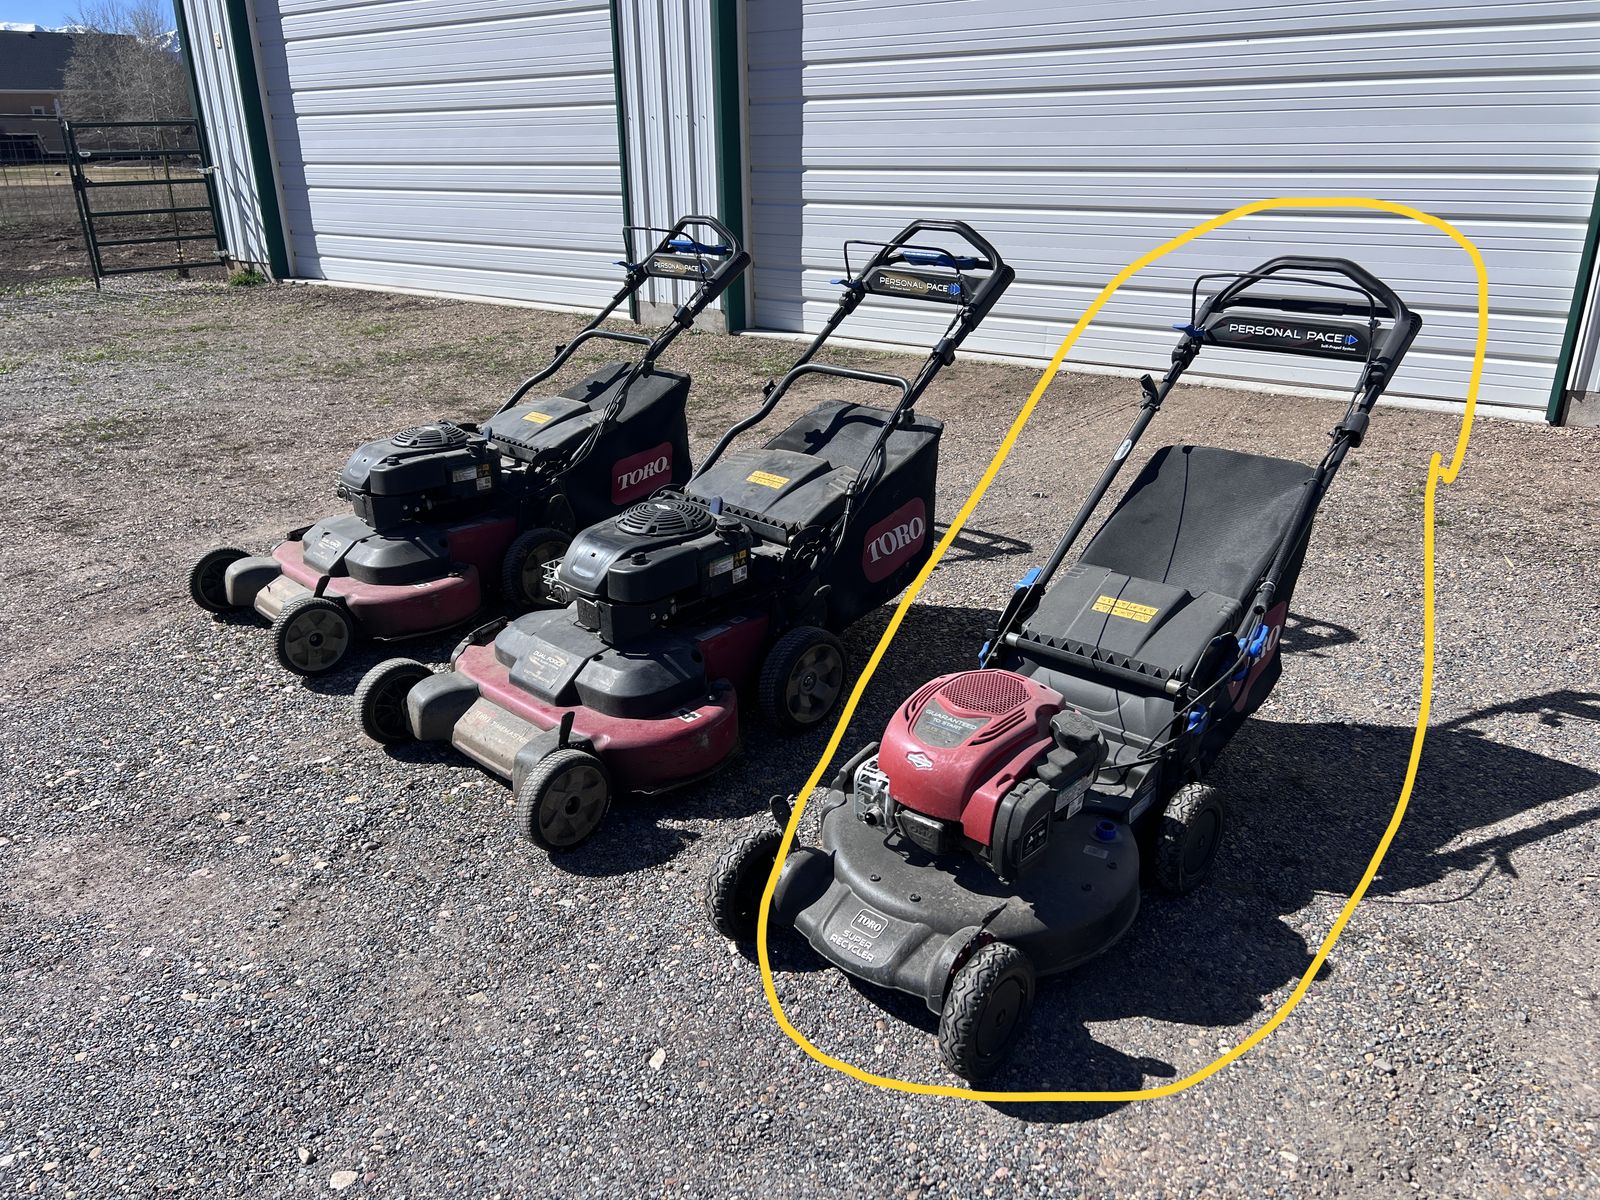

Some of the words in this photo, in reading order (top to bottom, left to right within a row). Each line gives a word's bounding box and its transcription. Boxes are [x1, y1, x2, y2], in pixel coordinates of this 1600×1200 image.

[653, 261, 683, 271] PERSONAL
[685, 264, 699, 272] PACE
[879, 276, 924, 289] PERSONAL
[926, 282, 949, 293] PACE
[1229, 323, 1302, 340] PERSONAL
[1306, 331, 1345, 344] PACE
[617, 456, 669, 491] TORO
[866, 516, 924, 564] TORO
[925, 708, 977, 731] GUARANTEED
[940, 721, 963, 731] START
[857, 914, 882, 932] TORO
[829, 933, 875, 963] RECYCLER
[842, 929, 873, 950] SUPER
